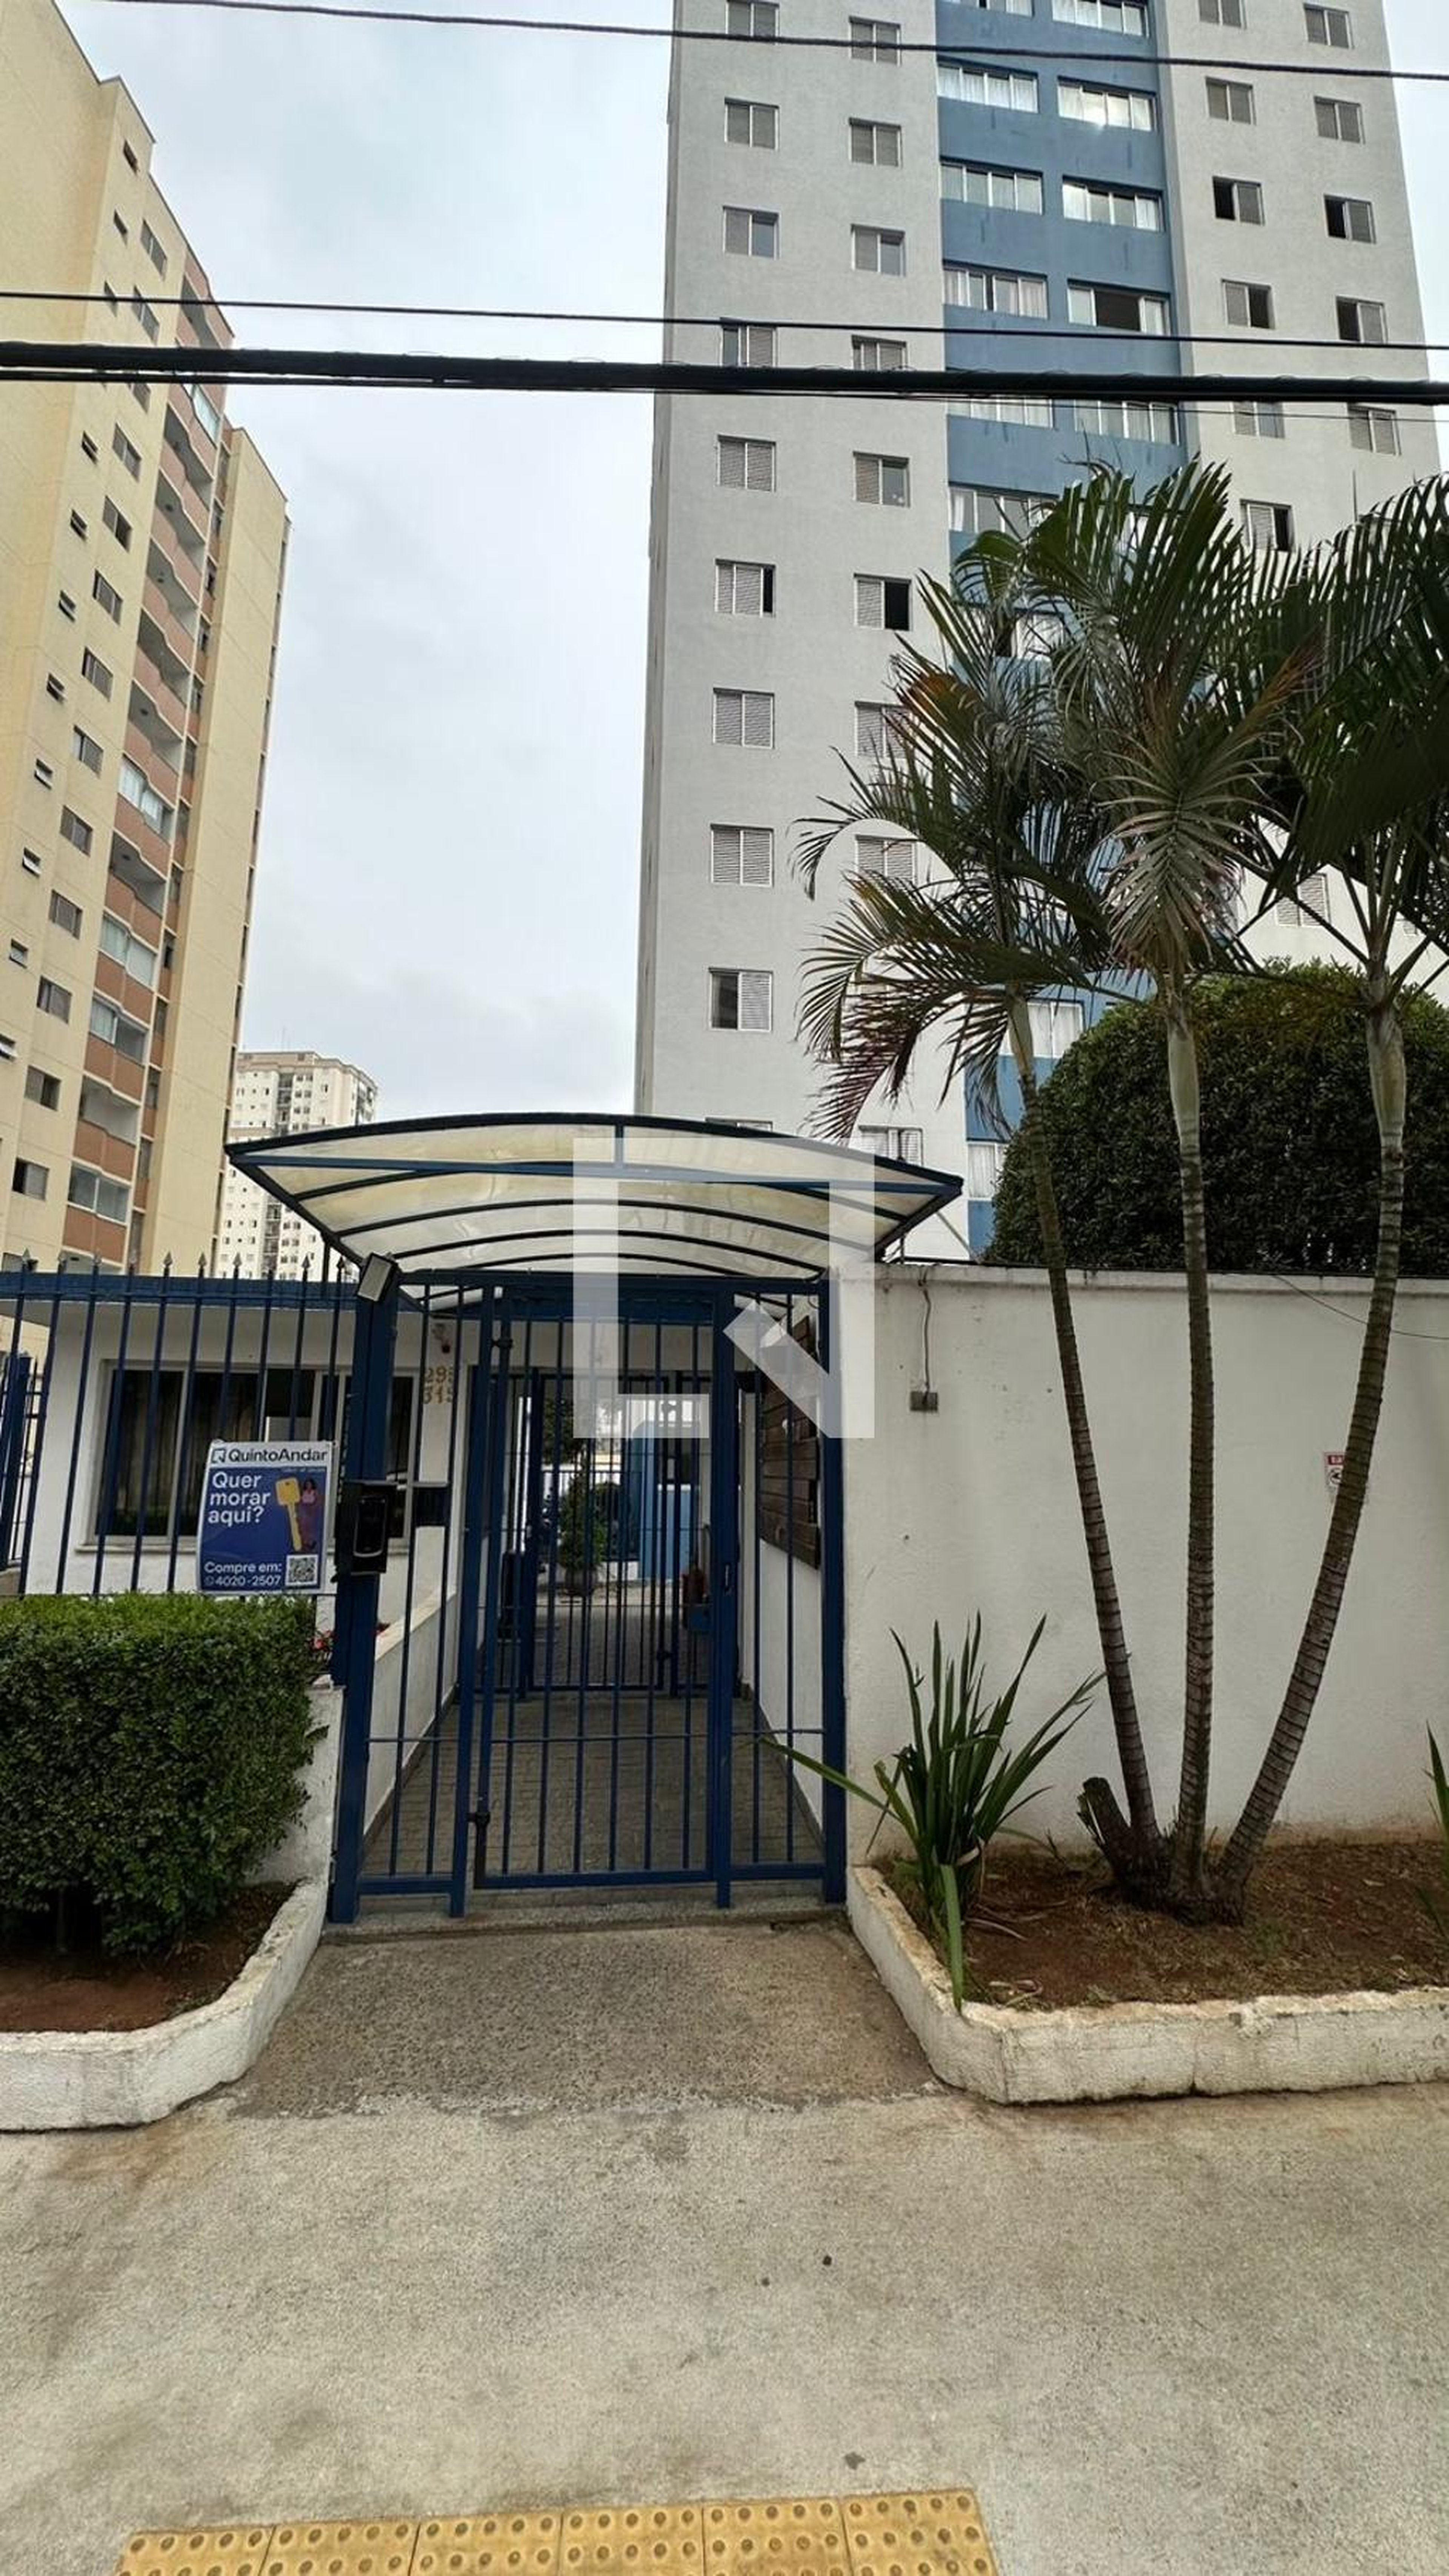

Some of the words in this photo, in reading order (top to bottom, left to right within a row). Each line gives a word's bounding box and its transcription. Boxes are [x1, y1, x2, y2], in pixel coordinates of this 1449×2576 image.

[228, 1449, 327, 1463] QuintoAndar
[212, 1472, 262, 1488] Quer
[209, 1491, 271, 1506] morar
[208, 1506, 264, 1527] aqui?
[204, 1561, 257, 1574] Compre
[258, 1563, 282, 1572] em:
